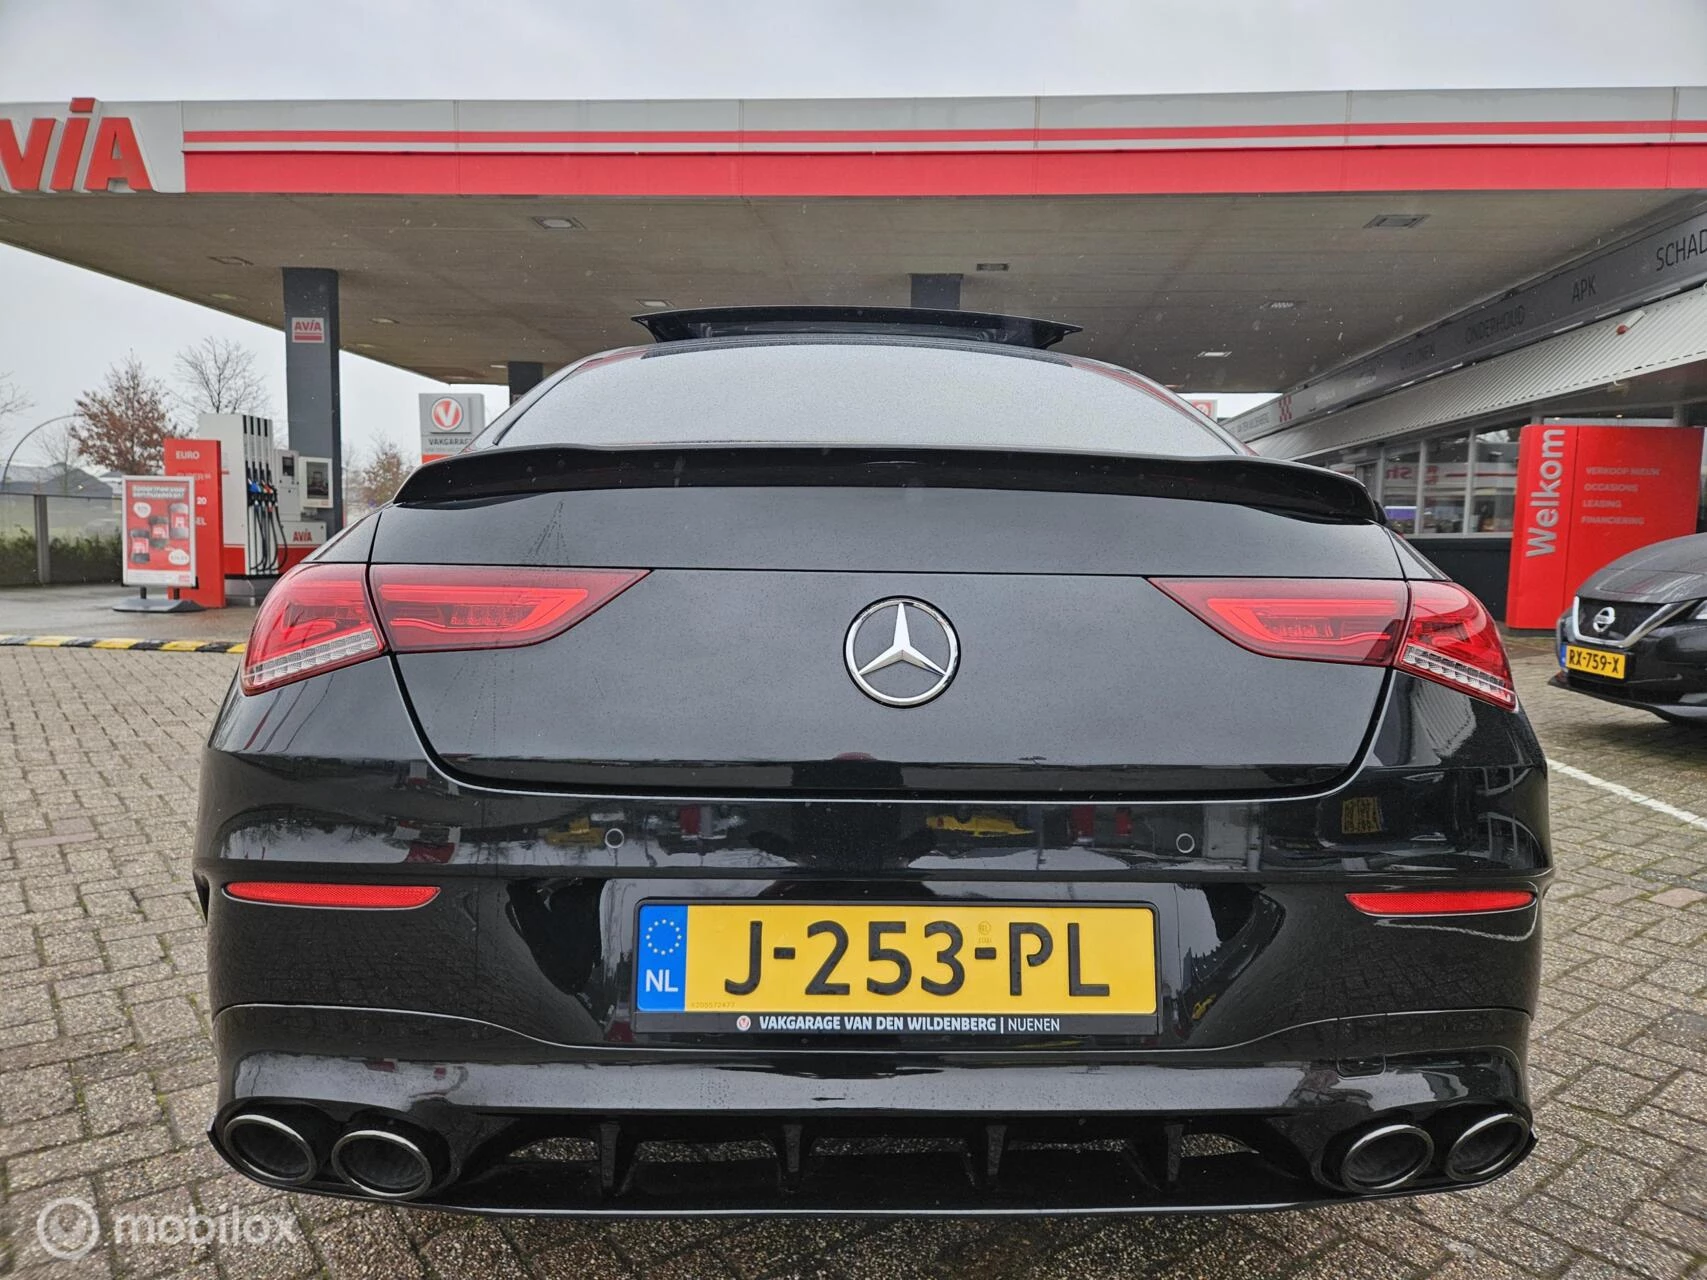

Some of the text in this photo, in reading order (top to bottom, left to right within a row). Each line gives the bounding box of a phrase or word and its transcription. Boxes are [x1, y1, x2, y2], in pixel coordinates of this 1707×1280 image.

[1571, 274, 1597, 305] APK
[428, 438, 473, 446] VAKGARAG
[175, 450, 201, 460] EURO
[1586, 466, 1630, 476] VERKOOP
[1525, 428, 1566, 558] Welkom
[1583, 483, 1639, 492] OCCASIONS
[196, 496, 208, 505] 20
[1582, 499, 1622, 508] LEASING
[1568, 648, 1619, 674] RX-759-X
[723, 920, 1111, 997] J-253-PL
[644, 968, 680, 994] NL
[758, 1015, 1061, 1033] VAKGARAGE VAN DEN WILDENBERG NUENEN
